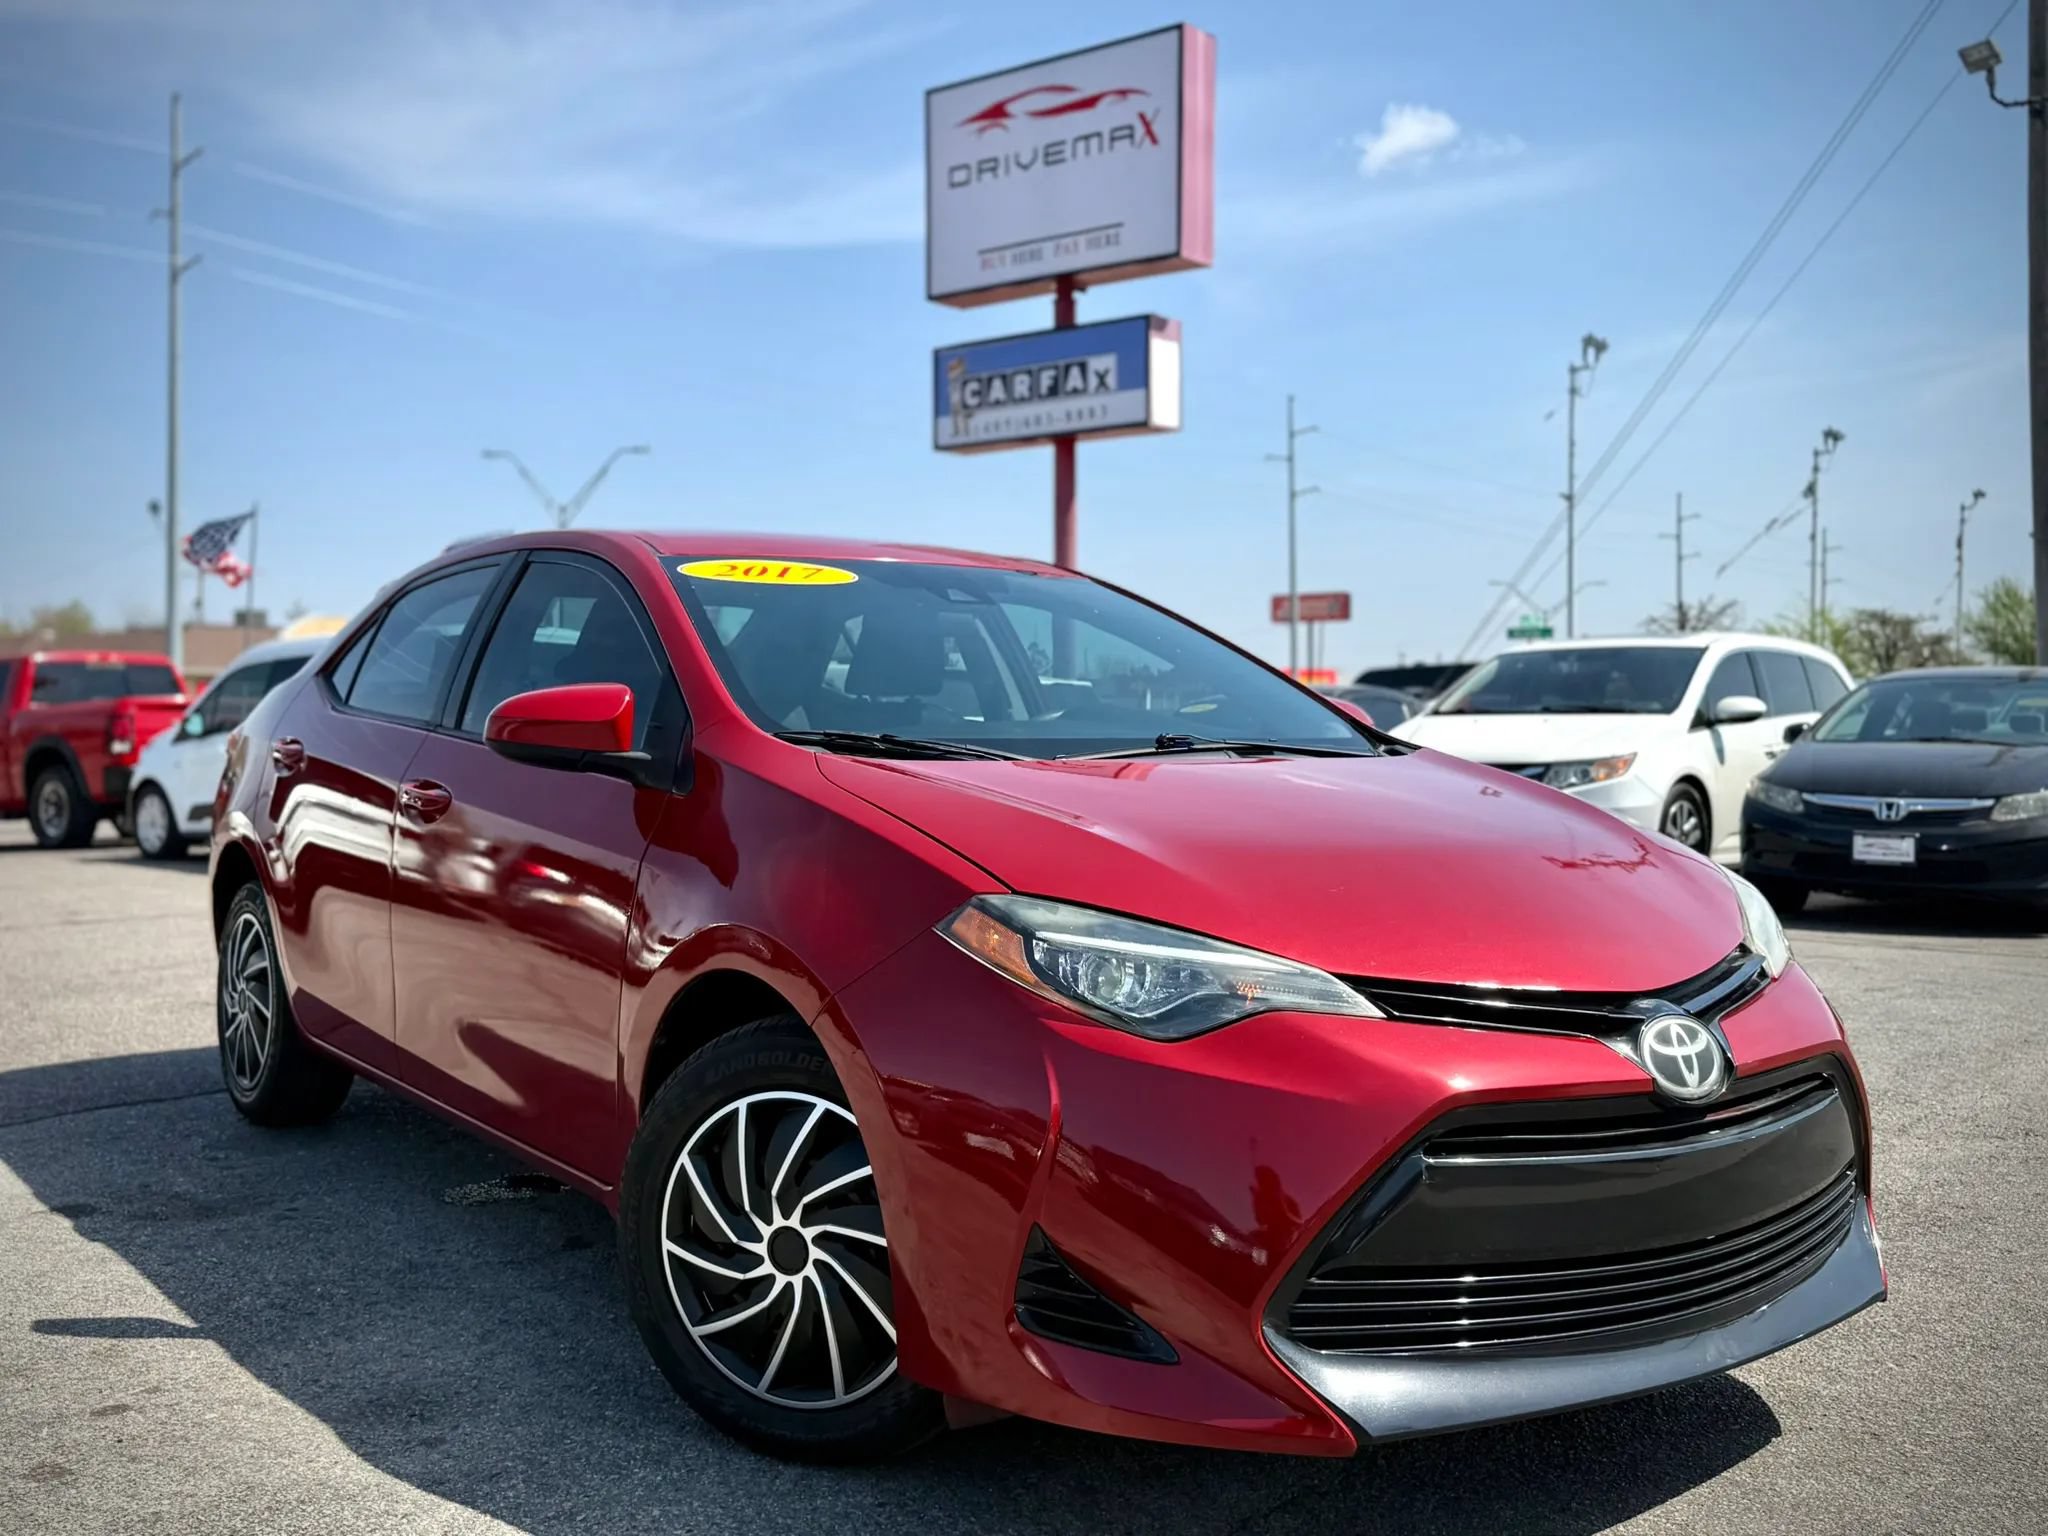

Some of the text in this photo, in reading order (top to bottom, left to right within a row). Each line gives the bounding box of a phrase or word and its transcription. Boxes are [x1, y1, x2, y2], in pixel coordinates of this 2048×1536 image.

[948, 108, 1160, 190] DRIVEMAX
[963, 362, 1113, 408] CARFAX
[713, 564, 824, 579] 2017
